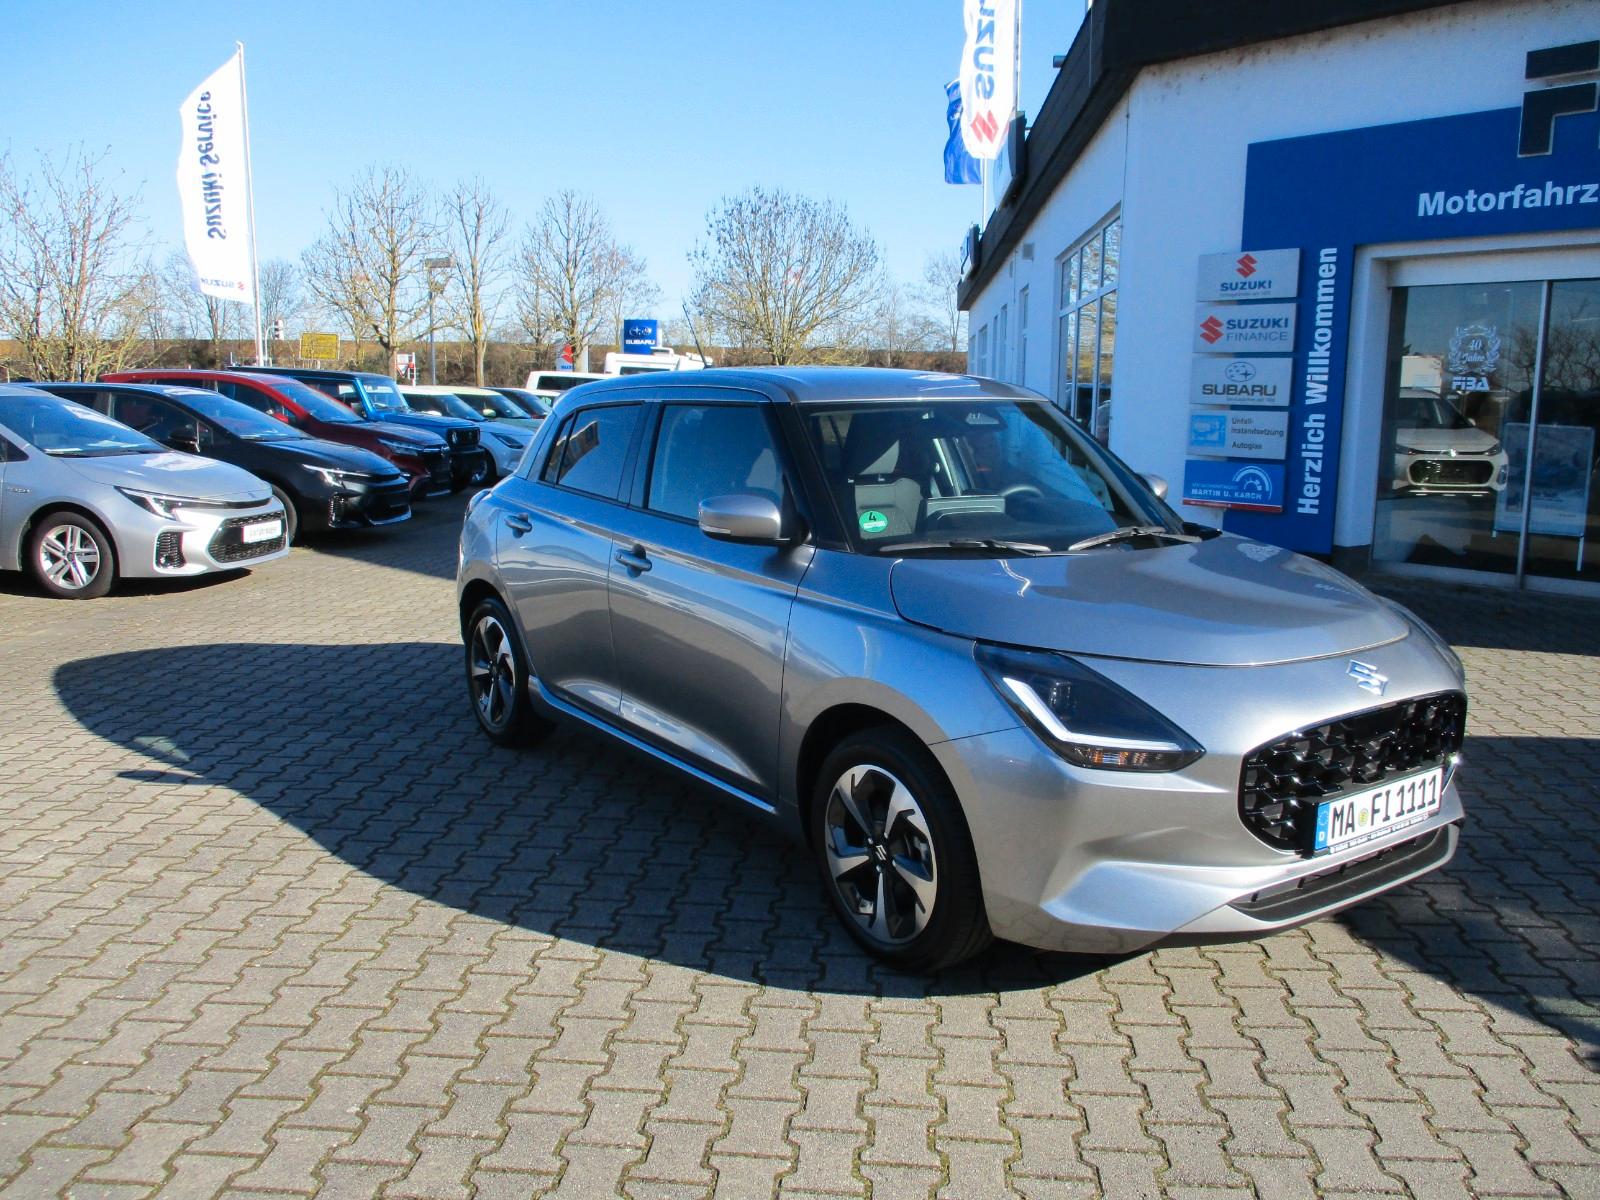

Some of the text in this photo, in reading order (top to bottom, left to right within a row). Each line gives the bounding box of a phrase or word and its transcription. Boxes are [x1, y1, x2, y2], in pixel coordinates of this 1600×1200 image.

[1219, 279, 1273, 292] SUZUKI
[1225, 317, 1289, 330] SUZUKI
[1225, 331, 1289, 342] FINANCE
[1297, 247, 1338, 514] Herzlich Willkommen
[1201, 383, 1278, 397] SUBARU
[1231, 441, 1263, 450] Autoglas
[1191, 488, 1221, 497] MARTIN
[868, 511, 877, 522] 4
[1331, 801, 1356, 839] MA
[1319, 831, 1325, 840] D
